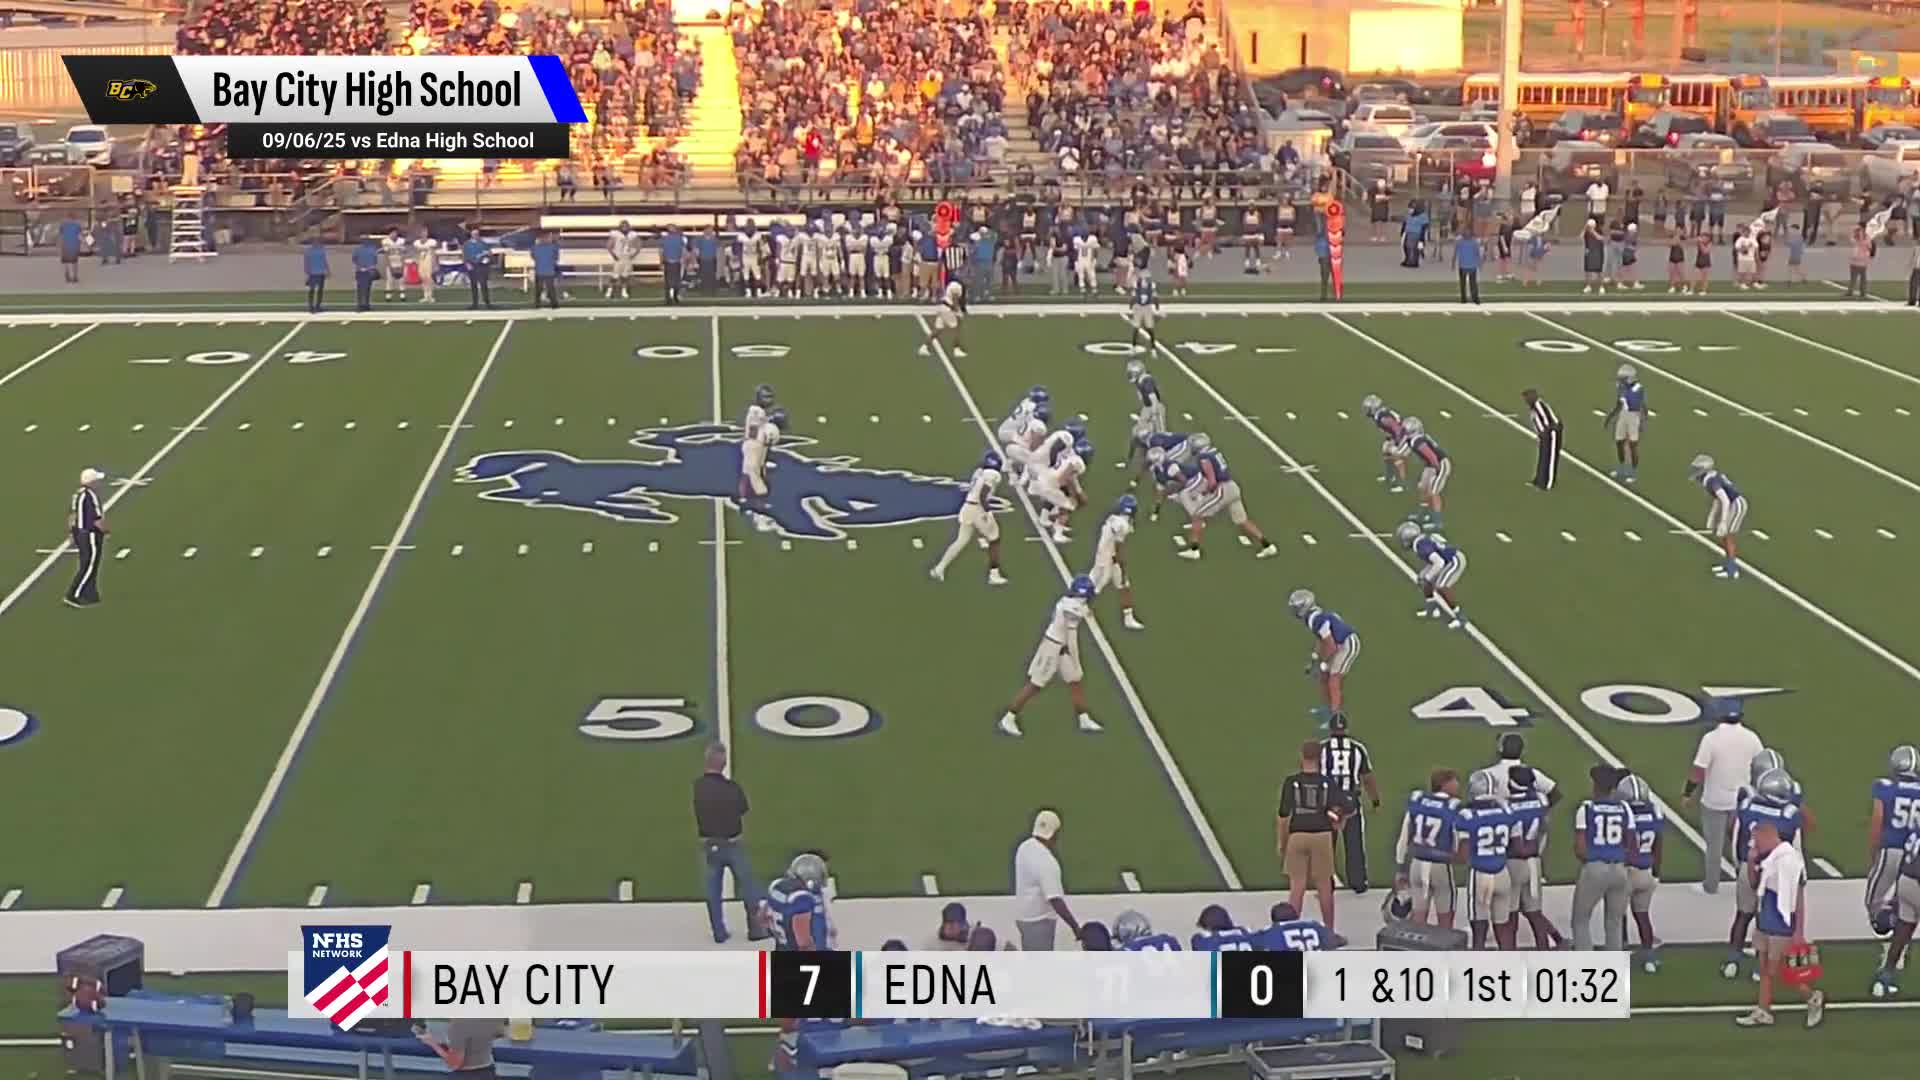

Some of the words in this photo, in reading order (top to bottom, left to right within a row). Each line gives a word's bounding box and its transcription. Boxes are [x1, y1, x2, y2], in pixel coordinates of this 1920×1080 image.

[1331, 750, 1350, 775] H
[1413, 814, 1443, 847] 17
[1477, 824, 1509, 856] 23
[1593, 815, 1622, 845] 16
